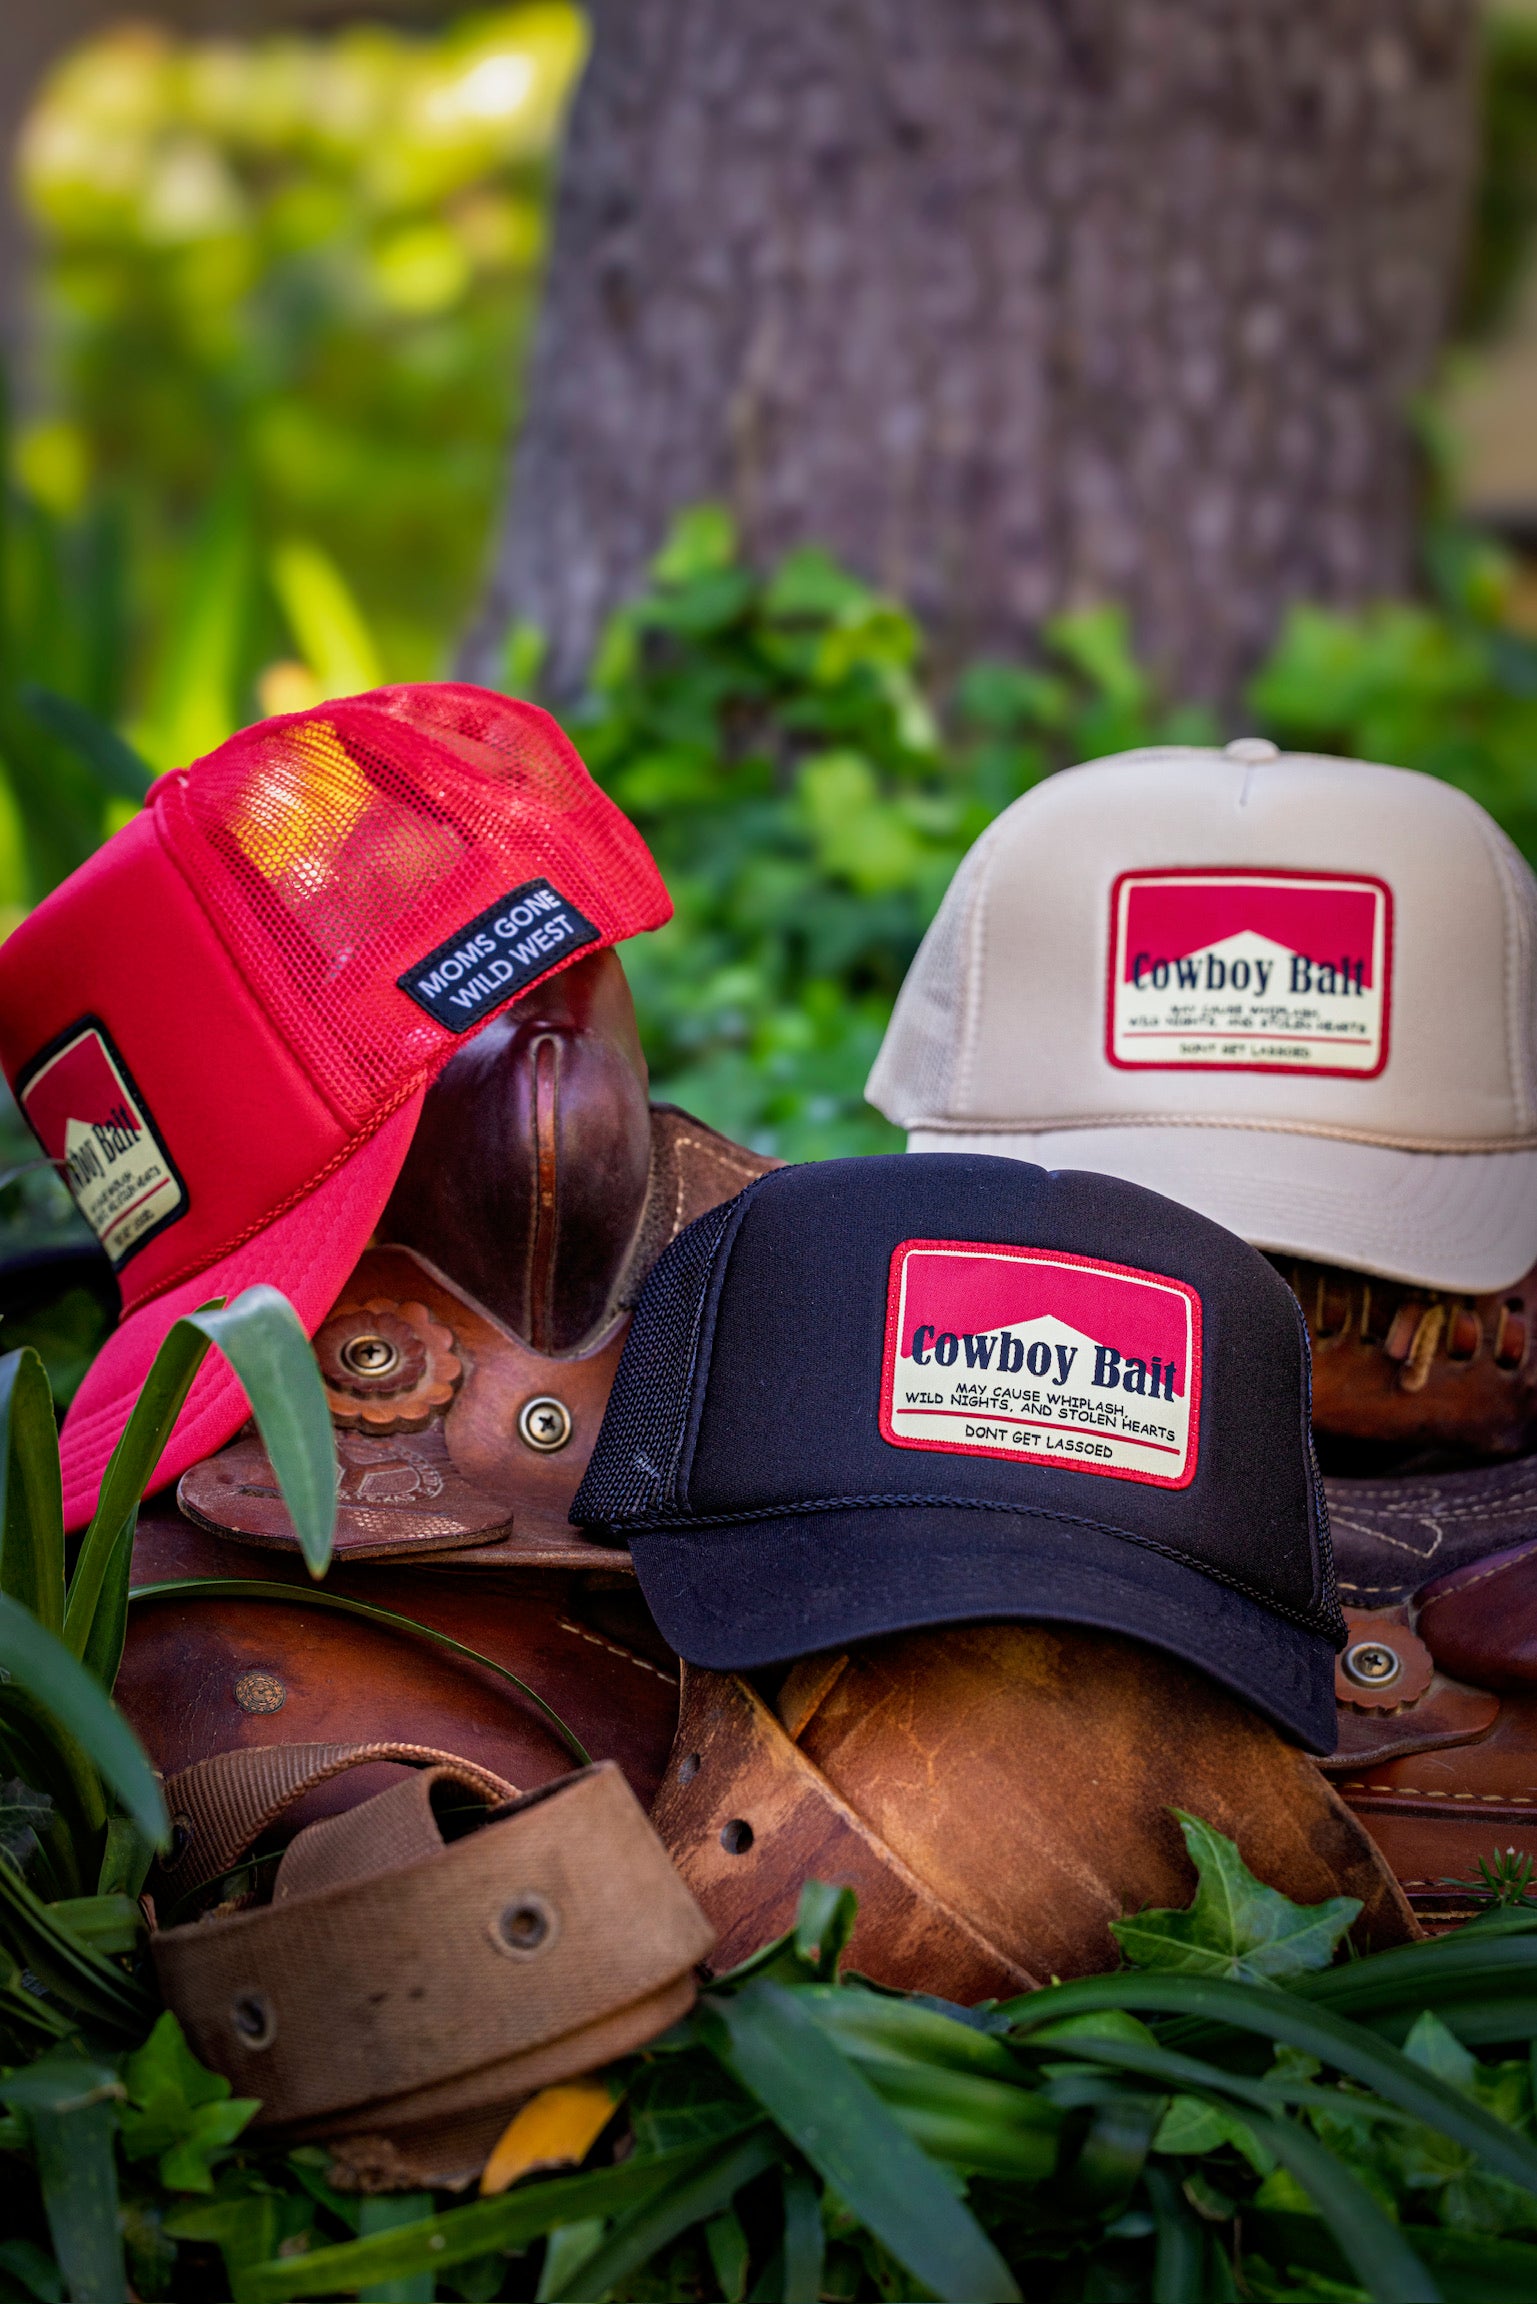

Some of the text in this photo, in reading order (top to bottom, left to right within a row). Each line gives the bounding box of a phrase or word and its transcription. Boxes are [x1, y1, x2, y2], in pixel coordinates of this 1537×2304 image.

[417, 889, 562, 999] MOMS GONE
[449, 914, 574, 1009] WILD WEST
[1132, 951, 1366, 998] Cowboy Bait
[92, 1103, 141, 1164] Bait
[911, 1324, 1178, 1403] Cowboy Bait
[905, 1391, 1176, 1442] WILD NIGHTS, AND STOLEN HEARTS
[955, 1382, 1129, 1419] MAY CAUSE WHIPLASH,
[965, 1423, 1113, 1459] DONT GET LASSOED
